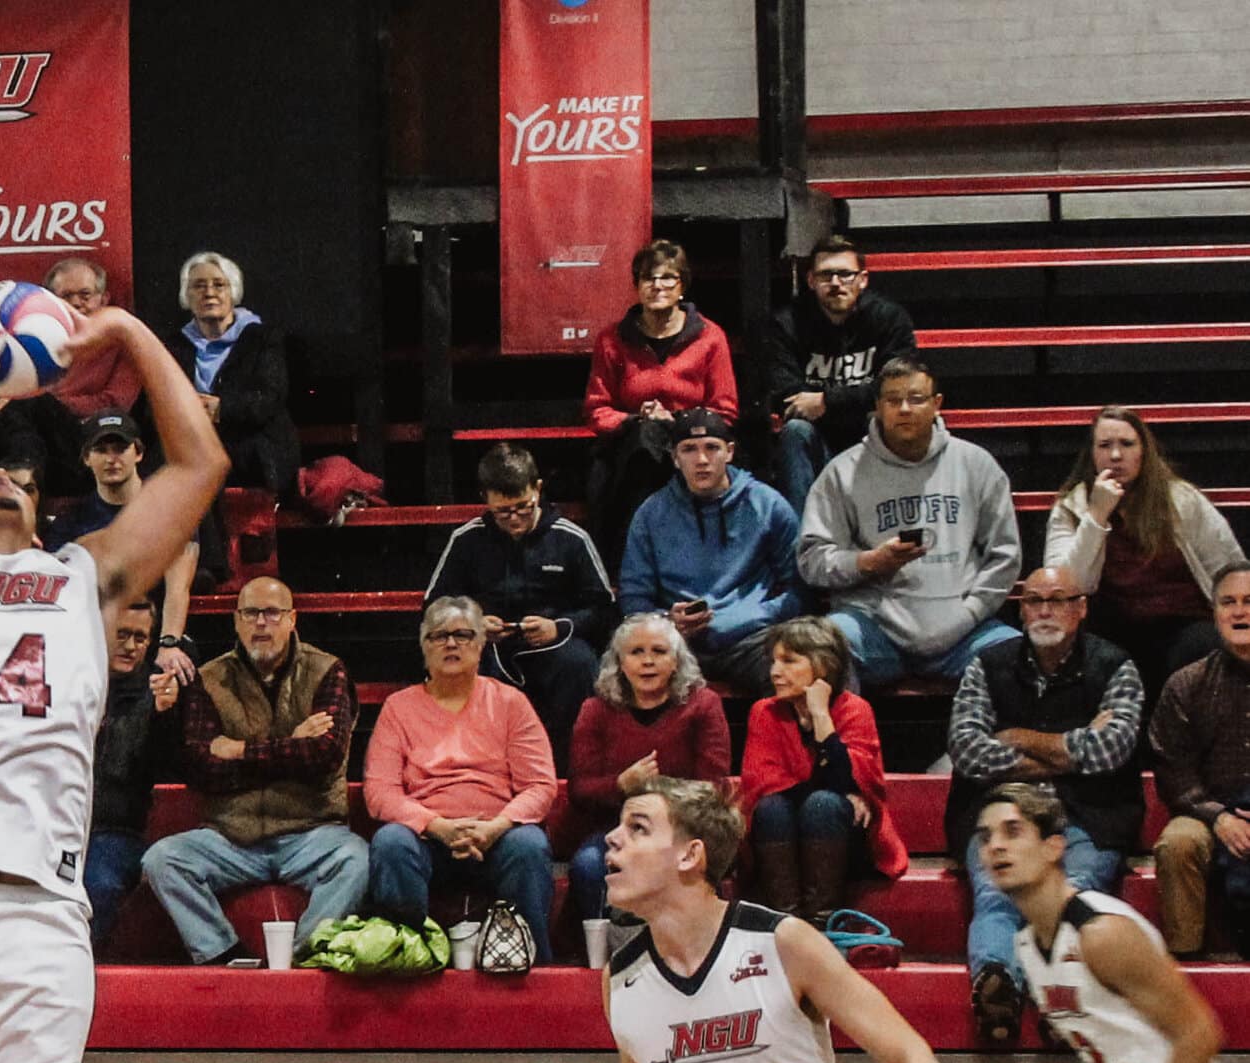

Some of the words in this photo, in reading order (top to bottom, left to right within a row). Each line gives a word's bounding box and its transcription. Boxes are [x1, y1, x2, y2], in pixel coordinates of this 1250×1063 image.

[557, 96, 621, 114] MAKE
[622, 95, 644, 112] IT
[505, 103, 642, 167] YOURS
[876, 493, 960, 533] HUFF
[669, 1008, 763, 1060] NGU
